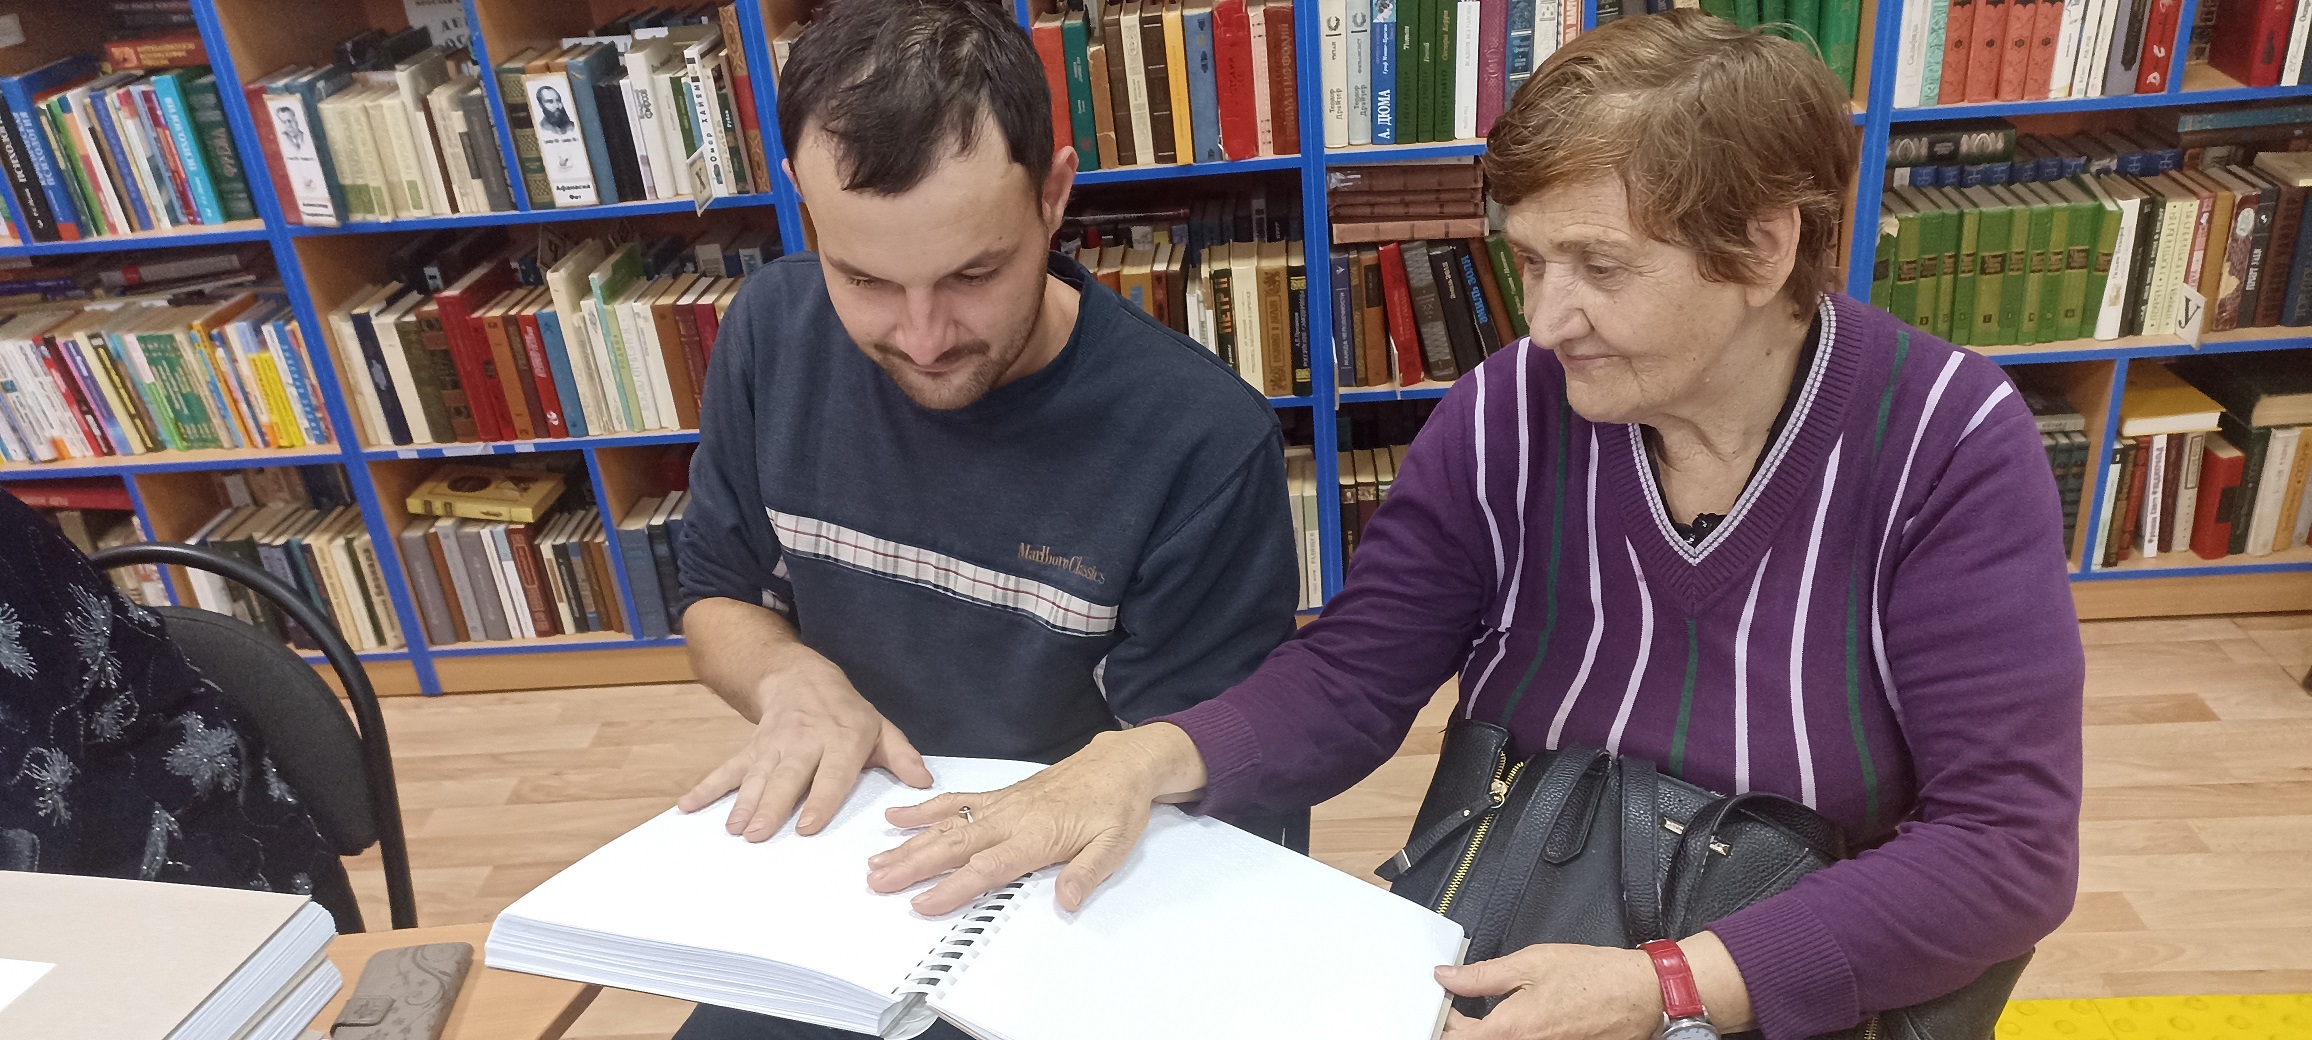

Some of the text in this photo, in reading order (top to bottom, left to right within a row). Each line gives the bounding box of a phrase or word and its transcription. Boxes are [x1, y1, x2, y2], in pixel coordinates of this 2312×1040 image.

[694, 84, 709, 124] ХАЙЯМ
[1335, 86, 1344, 120] Драйзер
[1353, 84, 1361, 110] Теодор
[1360, 83, 1369, 117] Драйзер
[1377, 88, 1393, 140] А. ДЮМА
[18, 110, 56, 187] ПСИХОЛОГИЯ
[164, 95, 198, 172] ПСИХОЛОГИЯ
[555, 183, 591, 192] Афанасий
[1460, 254, 1478, 286] ЗОЛЯ
[1217, 292, 1233, 334] ПЕТР
[2178, 295, 2201, 330] У
[1018, 542, 1106, 585] Marlboro Classics
